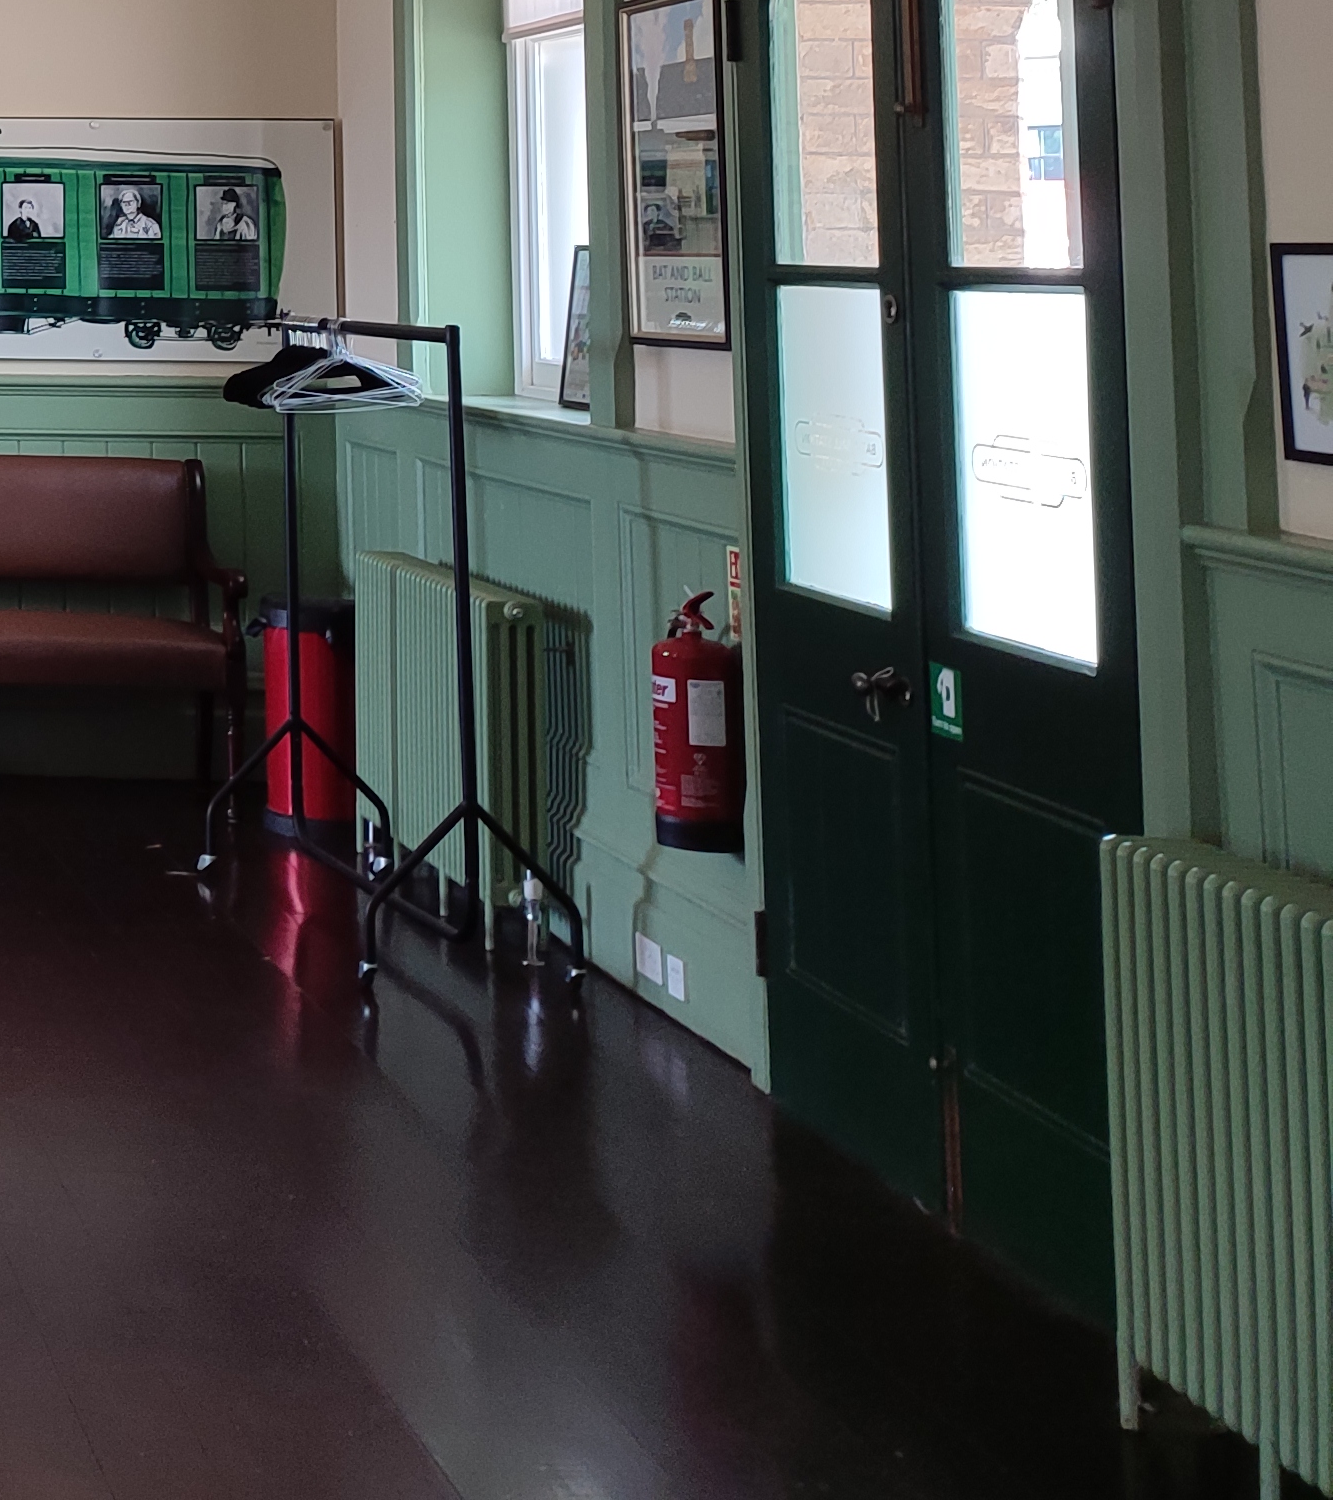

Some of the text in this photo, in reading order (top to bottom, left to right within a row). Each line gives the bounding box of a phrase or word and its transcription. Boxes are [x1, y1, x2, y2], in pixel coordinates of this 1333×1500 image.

[652, 264, 712, 282] BAT AND BALL
[664, 286, 701, 304] STATION
